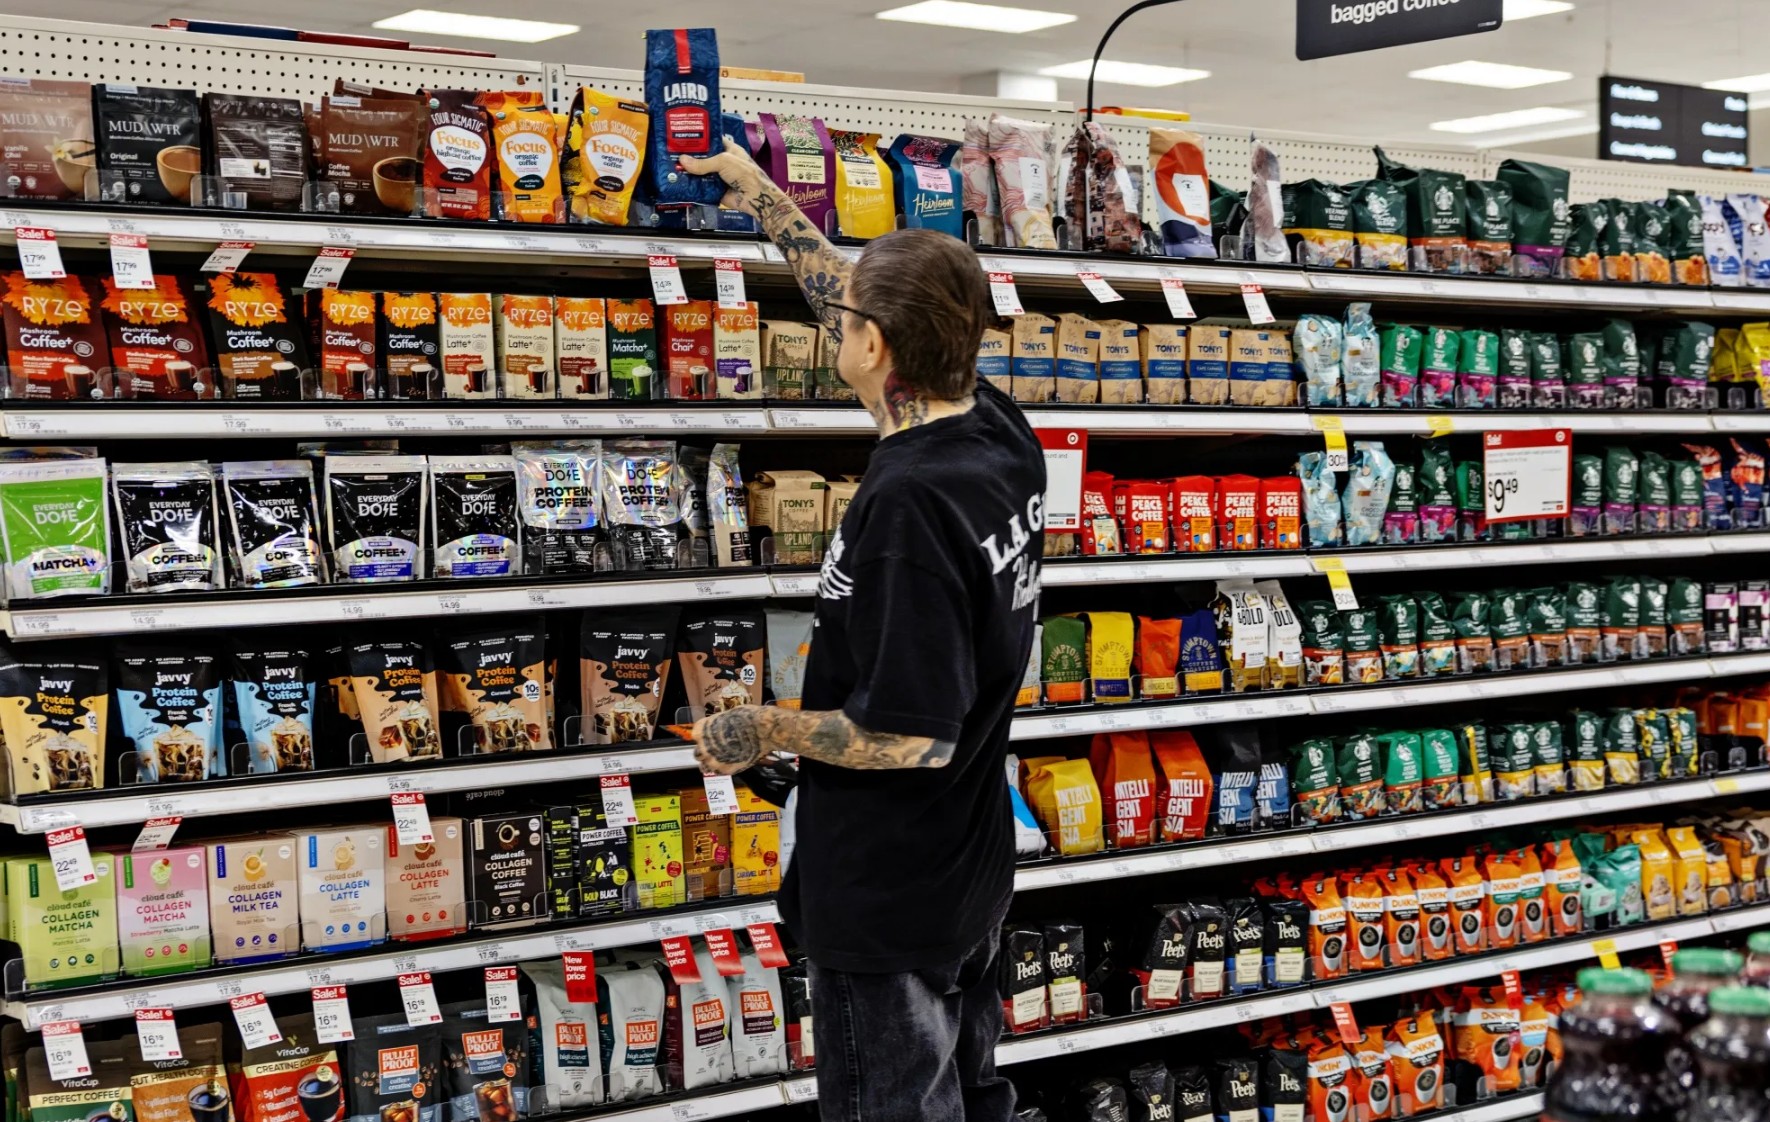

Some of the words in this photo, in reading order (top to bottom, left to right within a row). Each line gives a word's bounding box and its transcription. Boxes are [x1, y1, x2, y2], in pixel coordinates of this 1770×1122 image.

[1331, 0, 1398, 24] bagged
[431, 112, 451, 125] FOUR
[436, 131, 481, 150] Focus
[505, 140, 547, 155] Focus
[110, 152, 138, 160] Original
[913, 193, 955, 216] Heirloom
[17, 229, 45, 239] Sale!
[111, 235, 137, 246] Sale!
[321, 249, 346, 257] Sale!
[650, 257, 670, 266] Sale!
[715, 261, 735, 270] Sale!
[1132, 500, 1163, 510] PEACE
[1266, 496, 1298, 506] PEACE
[355, 548, 406, 558] COFFEE+
[458, 547, 505, 556] COFFEE+
[615, 646, 648, 659] javvy
[479, 652, 512, 667] javvy
[612, 661, 650, 670] Protein
[476, 666, 516, 678] Protein
[616, 670, 648, 679] Coffee
[39, 676, 72, 693] javvy
[155, 672, 191, 686] javvy
[481, 677, 515, 686] Coffee
[152, 687, 198, 697] Protein
[37, 693, 75, 706] Protein
[156, 698, 196, 707] Coffee
[42, 704, 74, 715] Coffee
[392, 794, 416, 804] Sale!
[485, 858, 532, 871] COLLAGEN
[492, 868, 527, 879] COFFEE
[228, 890, 282, 904] COLLAGEN
[137, 901, 192, 914] COLLAGEN
[232, 902, 257, 913] MILK
[260, 901, 279, 910] TEA
[42, 910, 99, 923] COLLAGEN
[144, 912, 185, 923] MATCHA
[49, 921, 93, 933] MATCHA
[566, 973, 586, 981] price
[136, 1010, 163, 1020] Sale!
[42, 1024, 71, 1034] Sale!
[276, 1047, 309, 1057] VitaCup
[256, 1062, 299, 1074] CREATINE
[382, 1057, 414, 1071] PROOF
[62, 1078, 99, 1088] VitaCup
[130, 1076, 149, 1086] GUT
[151, 1071, 187, 1082] HEALTH
[42, 1093, 82, 1104] PERFECT
[84, 1090, 120, 1101] COFFEE
